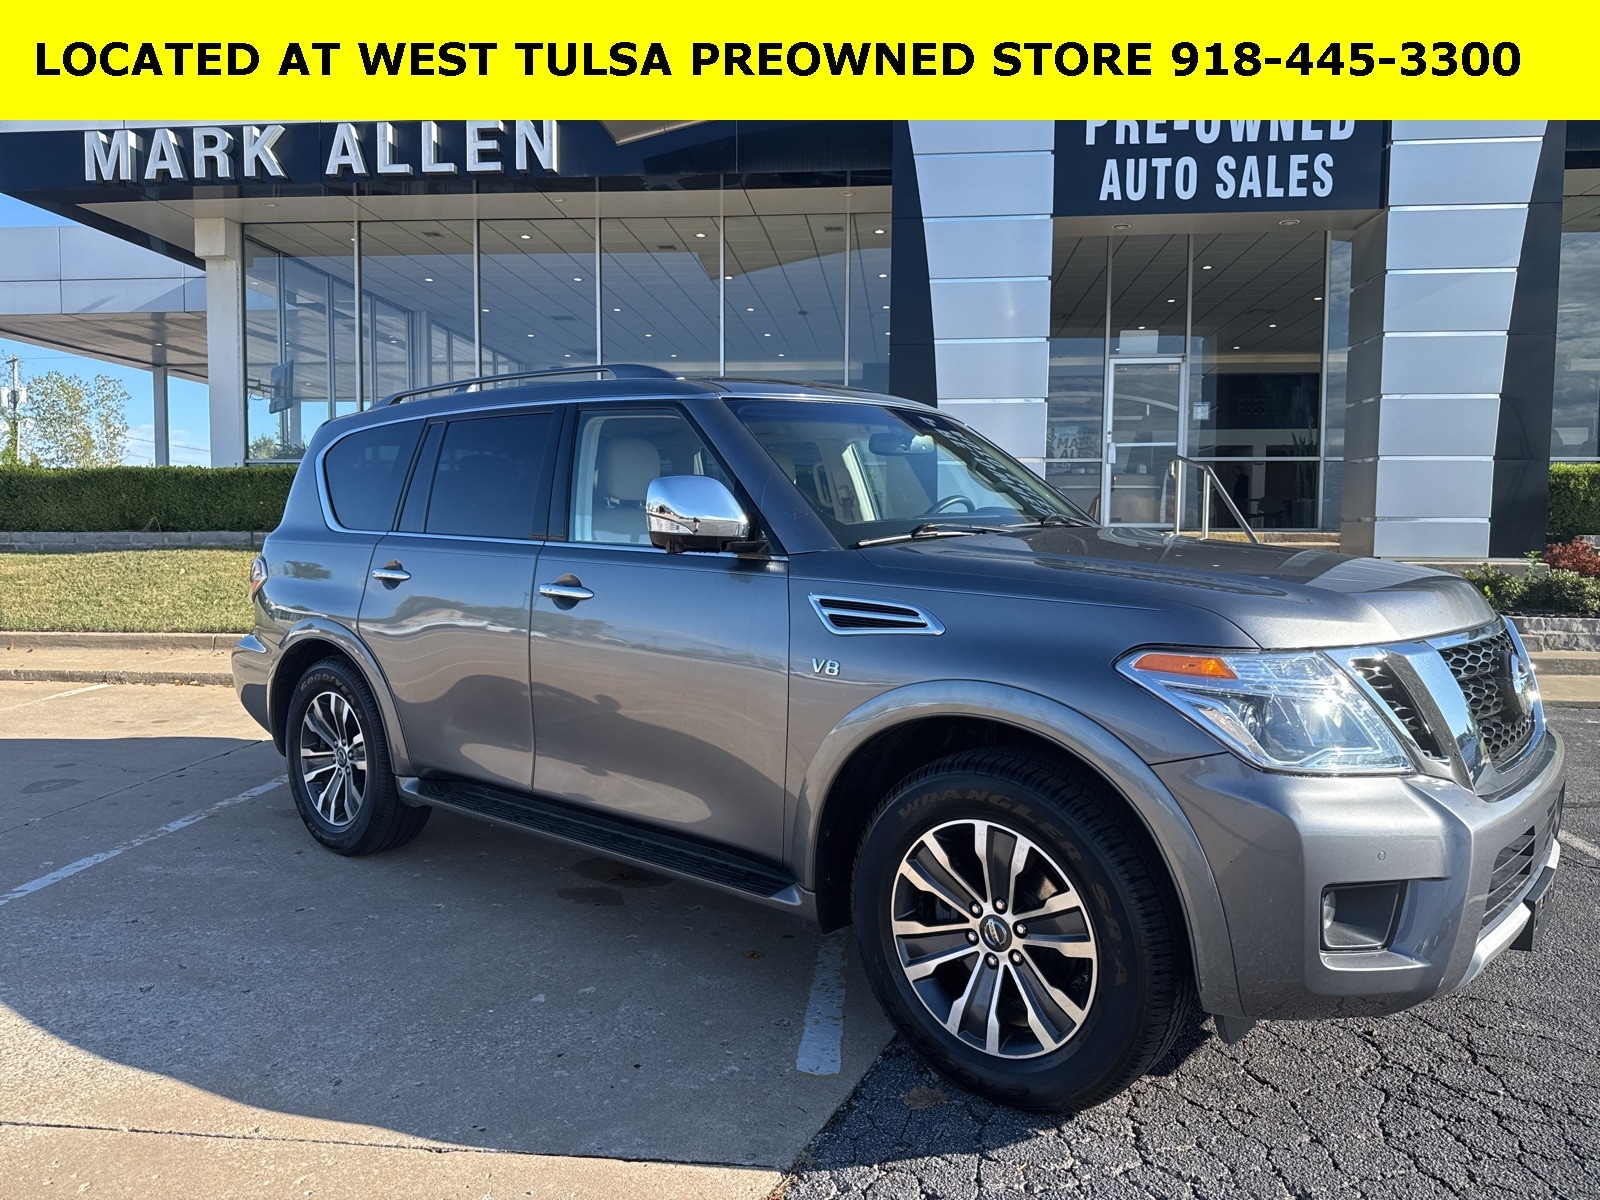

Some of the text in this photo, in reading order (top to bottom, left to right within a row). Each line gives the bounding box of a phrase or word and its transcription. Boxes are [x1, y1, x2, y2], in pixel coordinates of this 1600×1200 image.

[85, 119, 558, 181] MARK ALLEN
[1099, 153, 1334, 201] AUTO SALES
[811, 657, 841, 676] V8
[301, 673, 362, 720] GOODYEAR
[898, 788, 1082, 862] WRANGLER
